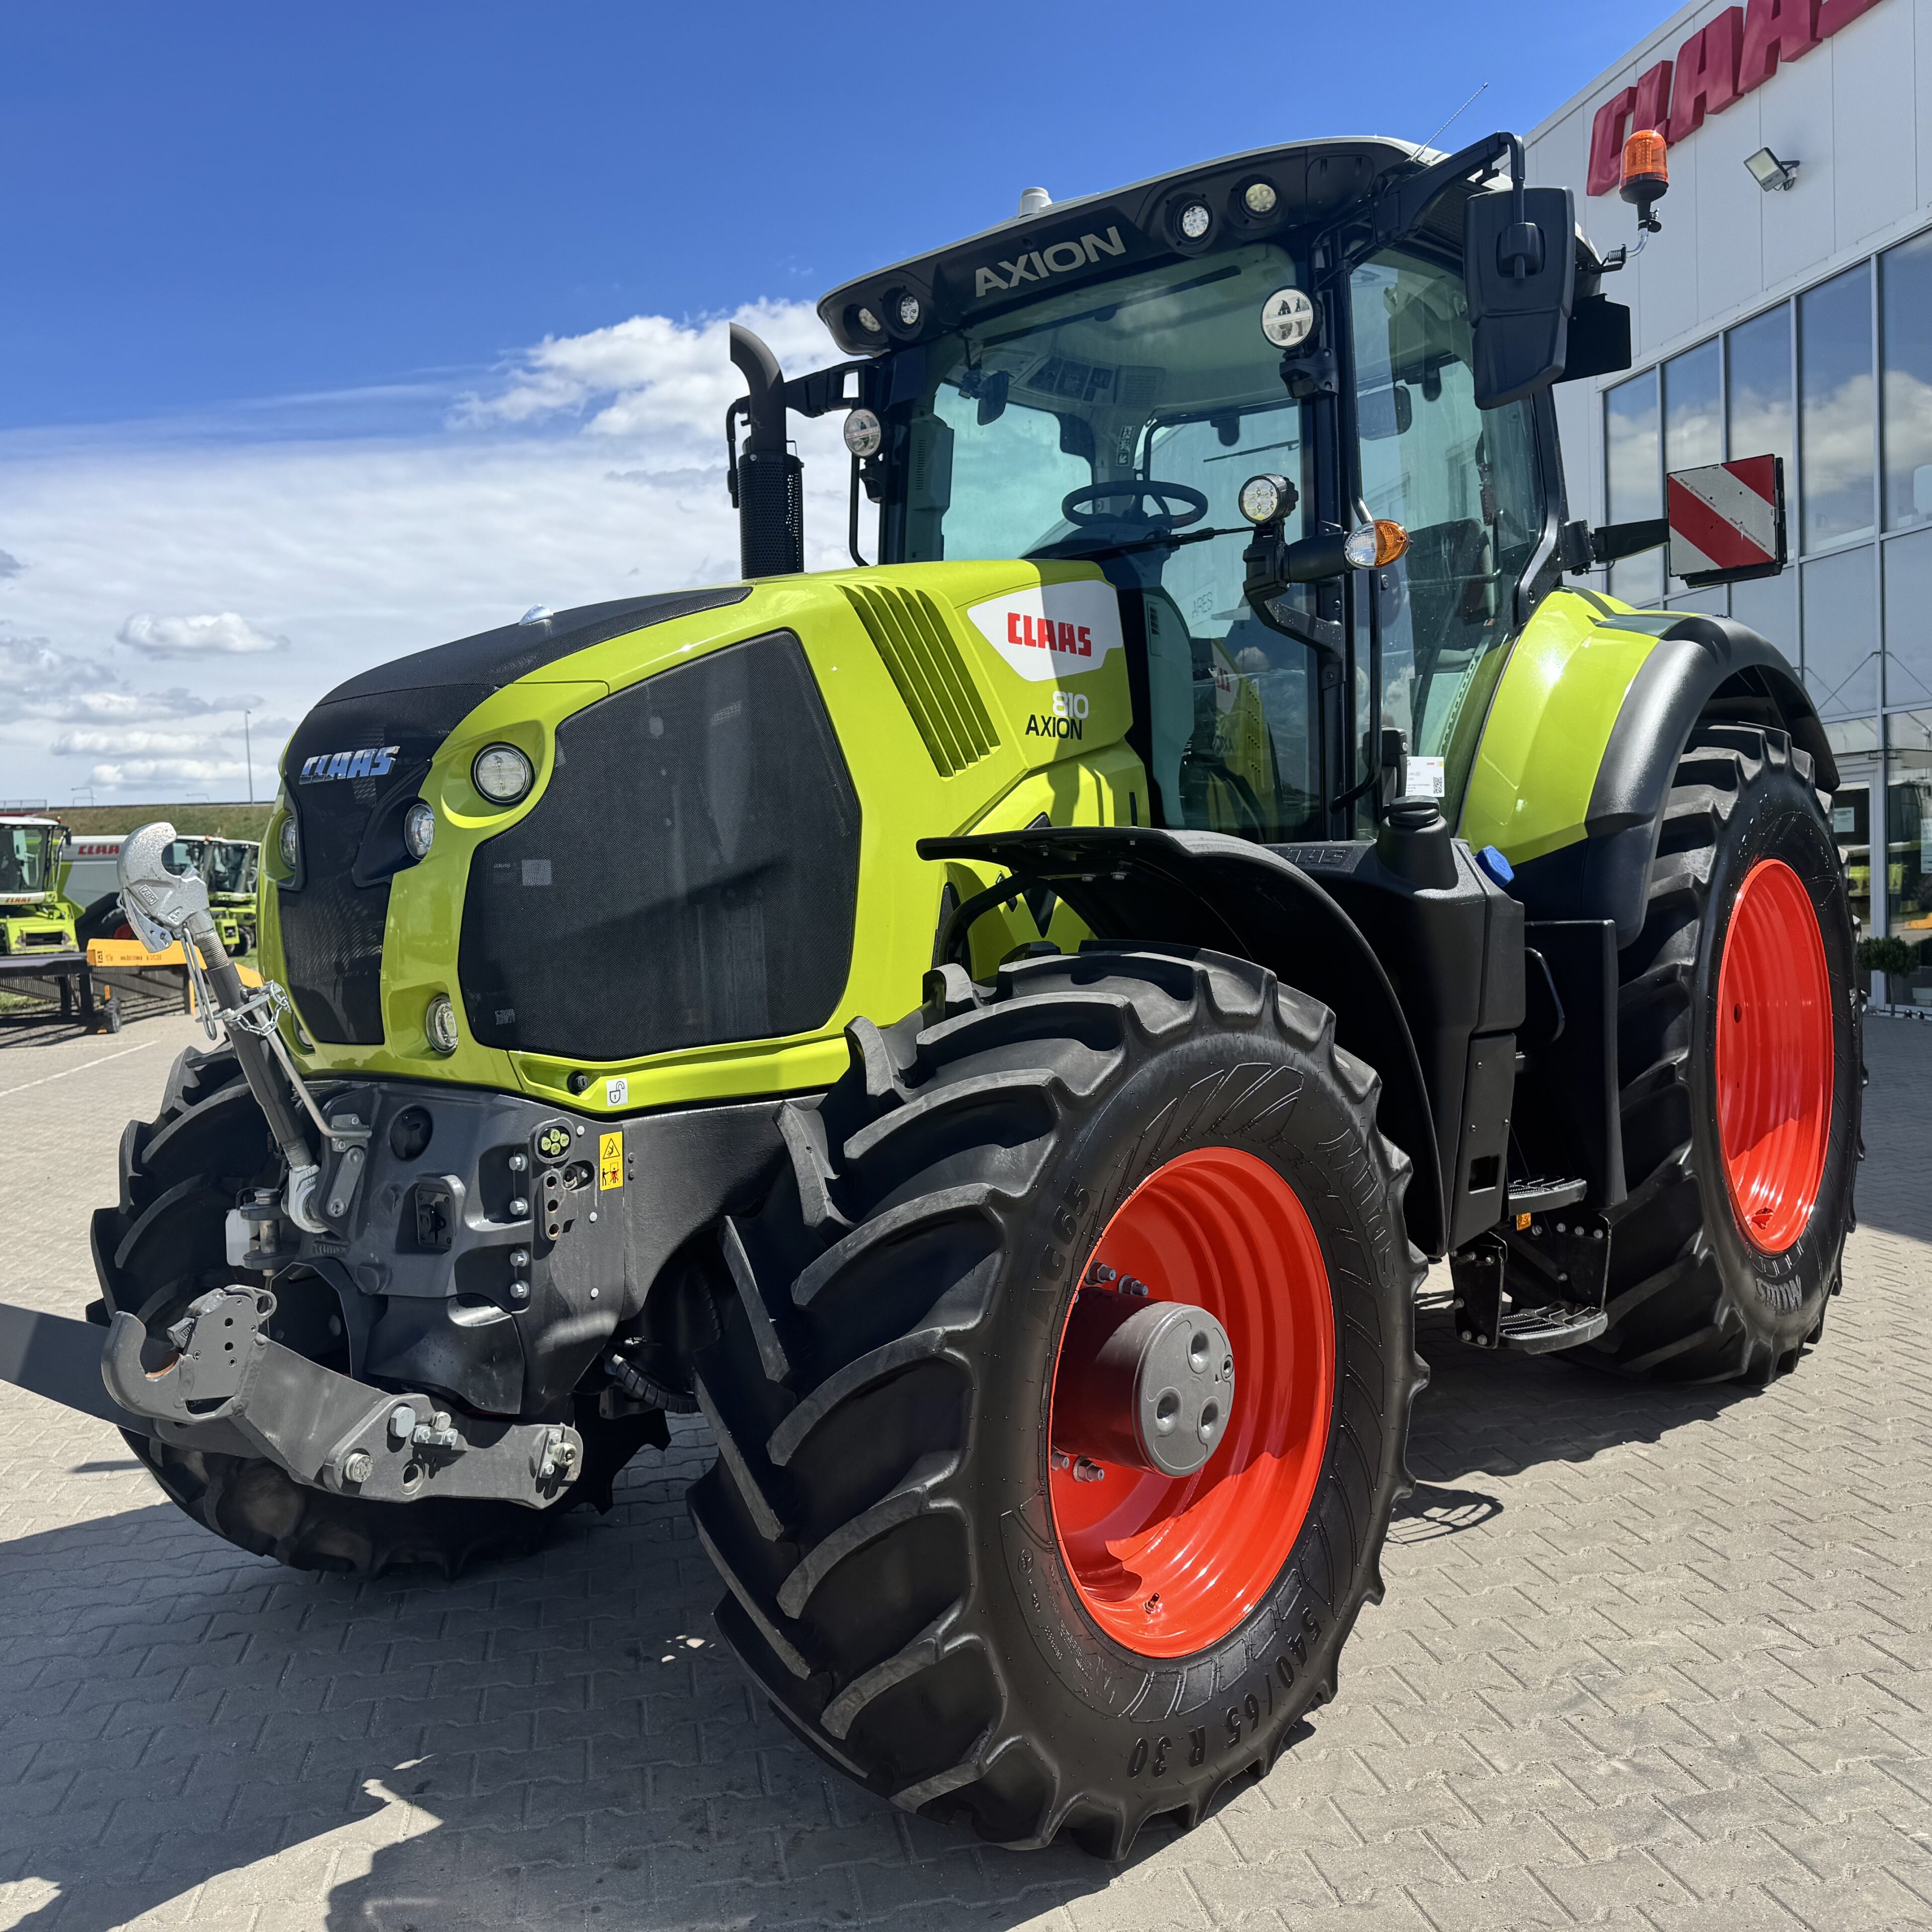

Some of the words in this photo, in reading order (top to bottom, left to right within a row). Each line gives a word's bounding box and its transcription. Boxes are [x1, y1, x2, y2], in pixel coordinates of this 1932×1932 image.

[1586, 0, 1882, 197] CLAA
[975, 226, 1126, 298] AXION
[1008, 612, 1092, 657] CLAAS
[1052, 690, 1089, 719] 810
[1025, 714, 1082, 740] AXION
[299, 746, 400, 785] CLAAS
[77, 845, 120, 855] CLAA
[1052, 1176, 1091, 1245] 65
[1226, 1605, 1323, 1748] 540/65
[1127, 1736, 1171, 1779] 30
[1188, 1725, 1206, 1767] R
